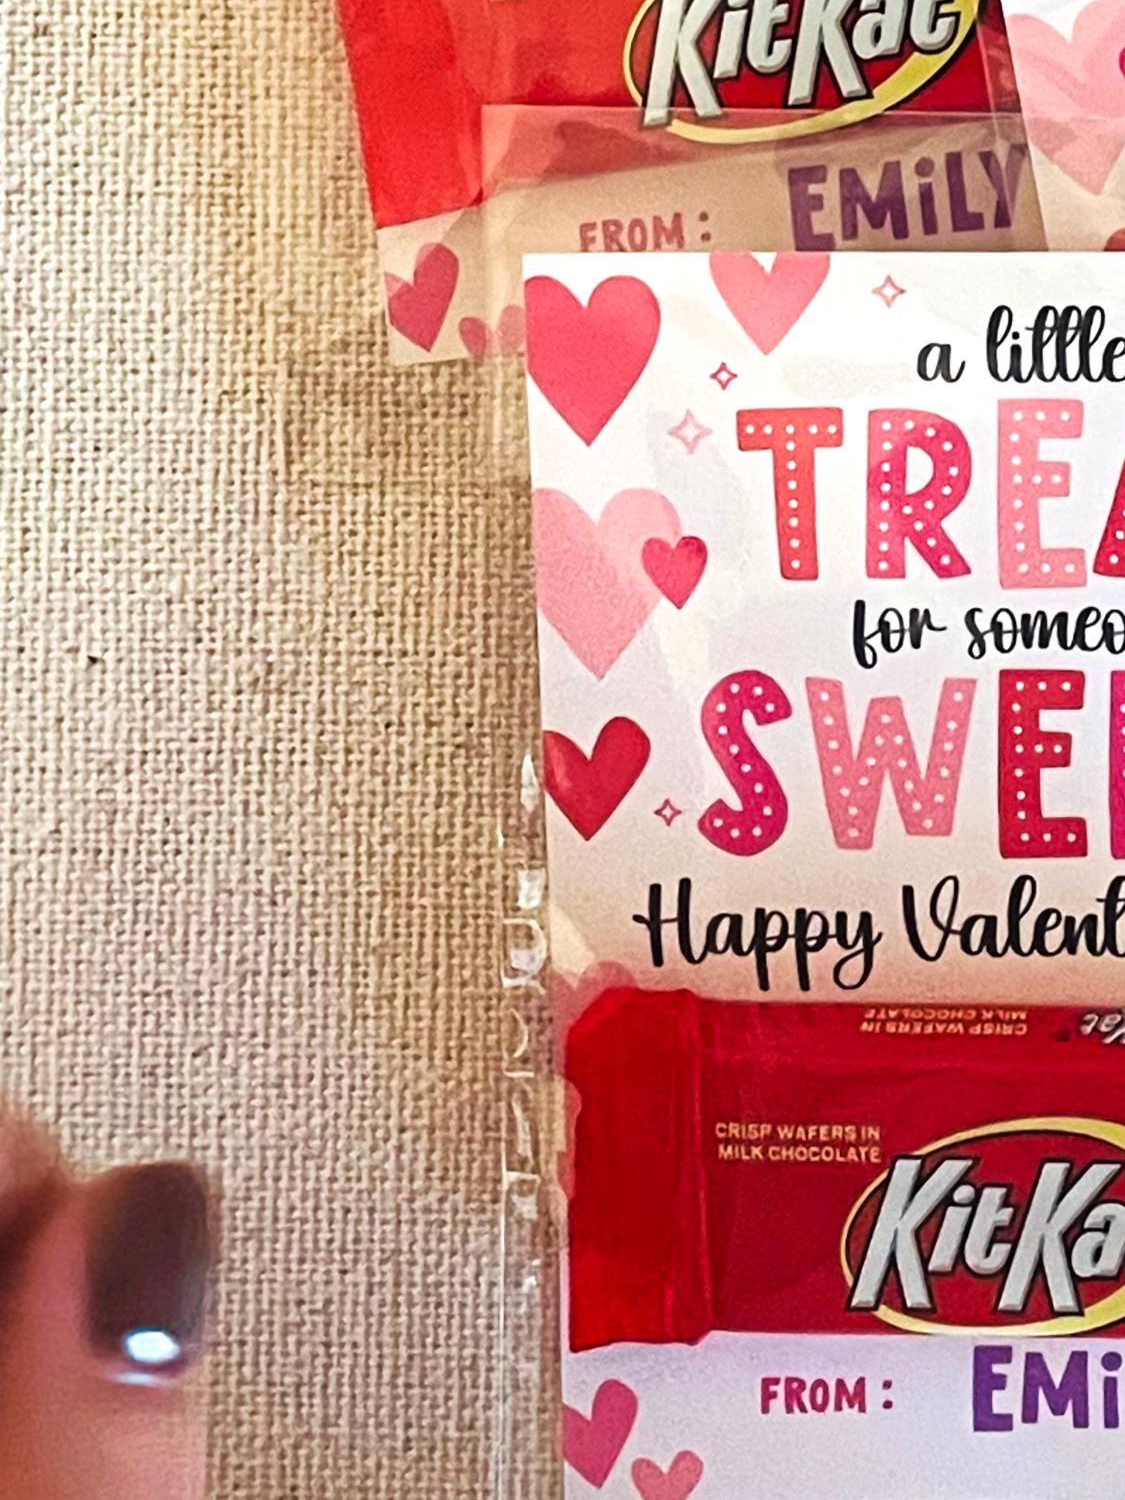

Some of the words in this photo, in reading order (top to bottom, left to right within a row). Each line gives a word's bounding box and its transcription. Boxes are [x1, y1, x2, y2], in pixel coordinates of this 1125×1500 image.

[916, 342, 967, 384] a
[852, 599, 948, 670] for
[632, 876, 883, 992] Happy
[715, 1121, 773, 1141] CRISP
[777, 1123, 860, 1142] WAFERS
[860, 1125, 882, 1141] IN
[717, 1143, 765, 1160] MILK
[768, 1145, 882, 1164] CHOCOLATE
